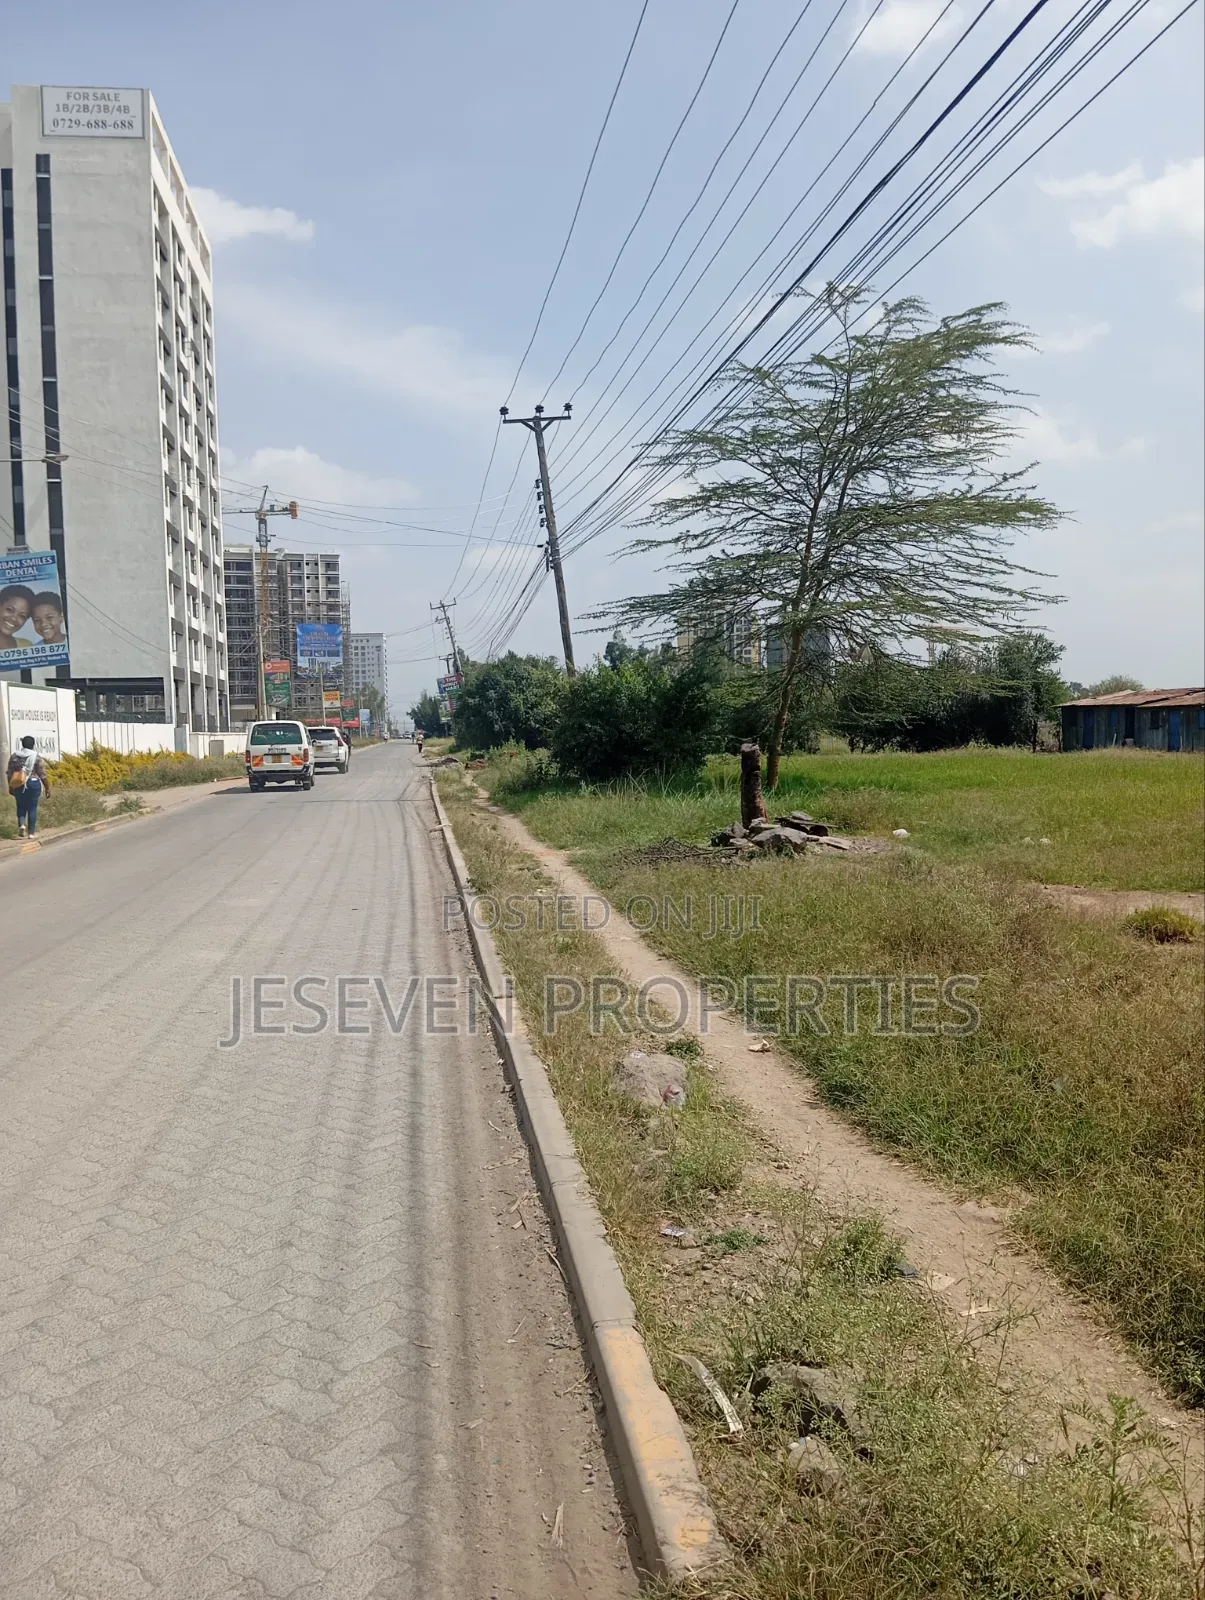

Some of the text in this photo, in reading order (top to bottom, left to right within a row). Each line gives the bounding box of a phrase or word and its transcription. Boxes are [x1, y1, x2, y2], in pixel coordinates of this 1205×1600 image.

[66, 91, 121, 102] FOR SALE
[55, 103, 131, 115] 1B/2B/3B/4B
[52, 118, 134, 130] 0729-688-688
[21, 556, 53, 567] SMILES
[5, 566, 38, 577] DENTAL
[3, 644, 66, 659] 0796 198 877
